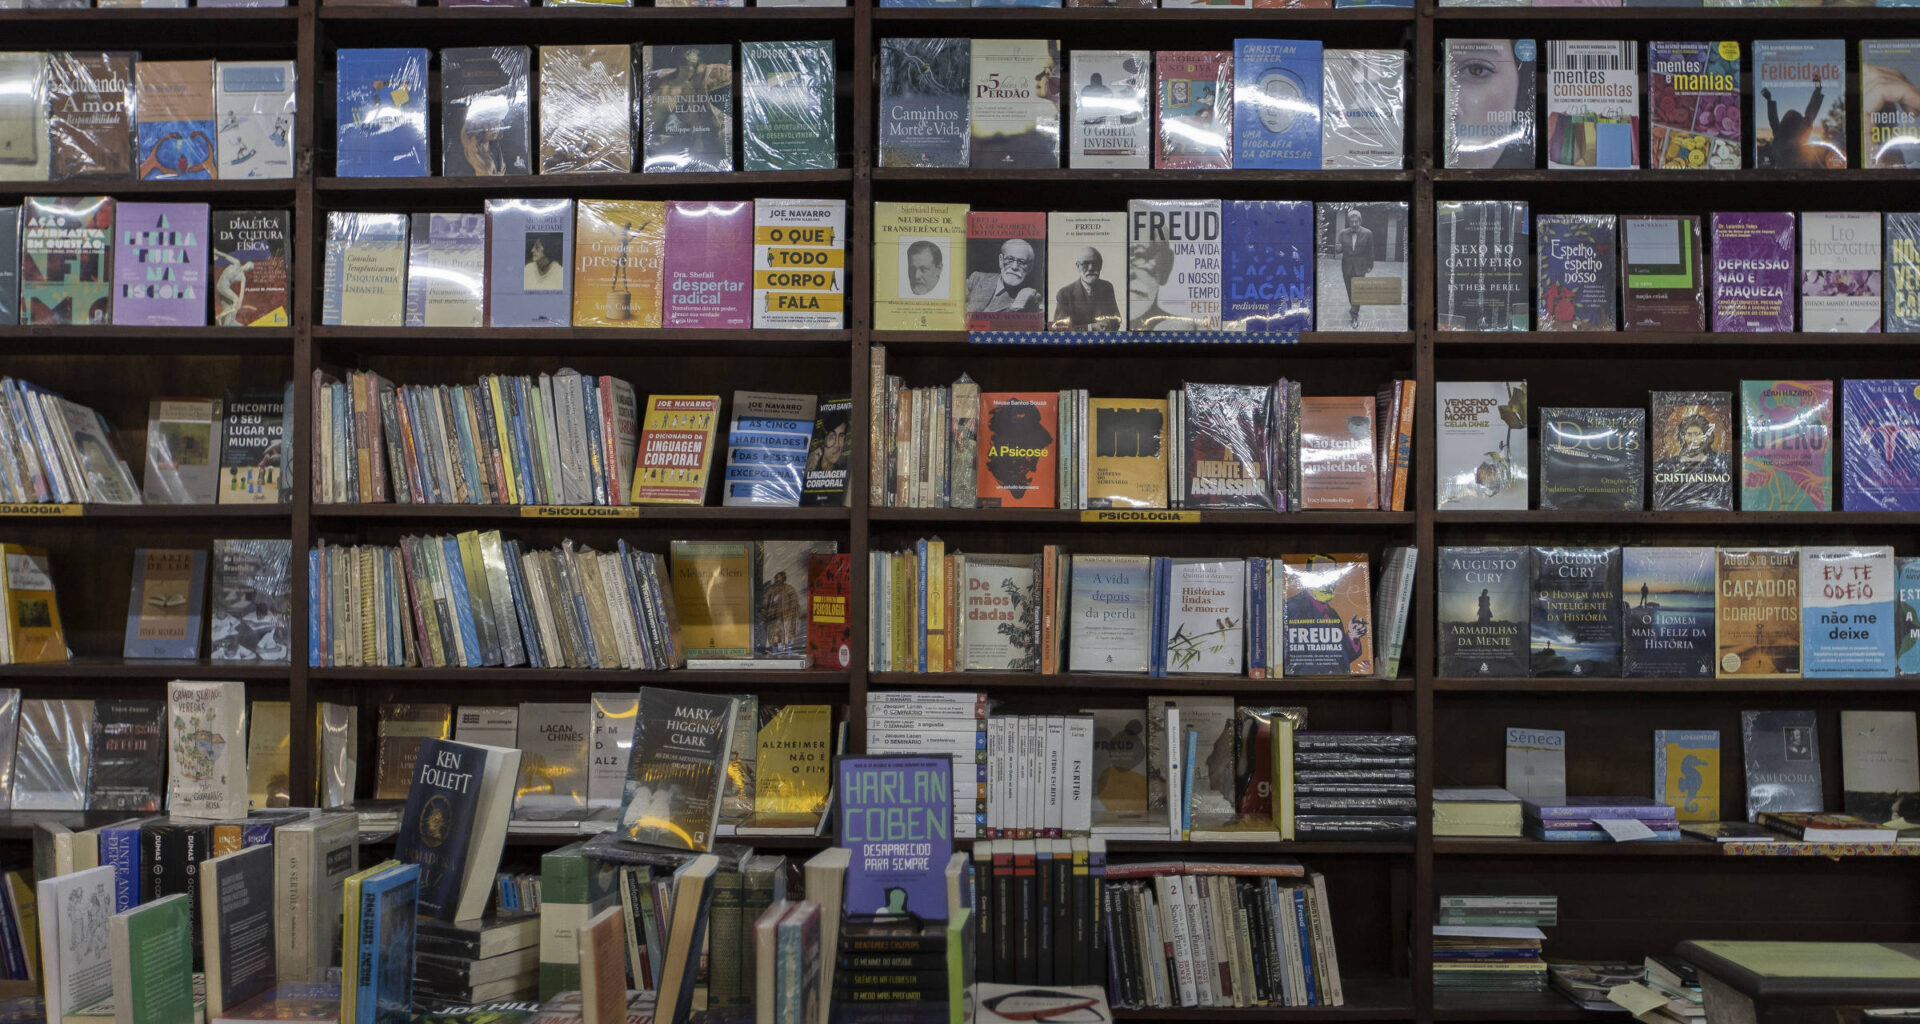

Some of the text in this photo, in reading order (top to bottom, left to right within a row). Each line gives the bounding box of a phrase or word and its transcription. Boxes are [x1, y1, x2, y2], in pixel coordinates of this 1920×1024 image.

[1243, 44, 1296, 54] CHRISTIAN
[1243, 55, 1282, 63] DUNKER
[1657, 61, 1700, 72] mentes
[1762, 62, 1839, 80] Felicidade
[988, 73, 1000, 89] 5
[1554, 69, 1604, 83] mentes
[1674, 72, 1733, 90] manias
[976, 84, 1029, 99] PERDÃO
[1554, 82, 1632, 96] consumistas
[62, 99, 124, 112] Amor
[668, 104, 707, 113] VELADA
[892, 106, 958, 121] Caminhos
[1488, 110, 1530, 122] mentes
[1870, 110, 1915, 123] mentes
[890, 122, 923, 135] Morte
[1084, 126, 1136, 137] O GORILA
[1242, 130, 1261, 139] UMA
[1084, 136, 1136, 148] INVISÍVEL
[1242, 140, 1291, 149] BIOGRAFIA
[1242, 150, 1255, 159] DA
[770, 210, 831, 218] JOE NAVARRO
[931, 207, 948, 215] Freud
[28, 216, 65, 227] AÇÃO
[230, 216, 279, 229] DIALÉTICA
[1133, 211, 1220, 241] FREUD
[220, 231, 283, 240] DA CULTURA
[771, 230, 824, 244] O QUE
[1832, 225, 1854, 241] LEO
[601, 241, 632, 255] poder
[1174, 244, 1220, 255] UMA VIDA
[1454, 244, 1487, 254] SEXO
[1551, 239, 1596, 259] Espelho,
[582, 255, 657, 272] presença
[780, 252, 828, 264] TODO
[1195, 258, 1220, 270] PARA
[1564, 256, 1602, 272] espelho
[1719, 257, 1789, 270] DEPRESSÃO
[346, 273, 398, 283] PSIQUIATRIA
[768, 273, 825, 286] CORPO
[1179, 273, 1220, 284] O NOSSO
[1565, 271, 1596, 283] nosso
[1719, 271, 1744, 283] NÃO
[346, 286, 384, 294] INFANTIL
[673, 279, 744, 293] despertar
[1231, 283, 1304, 299] LACAN
[1490, 283, 1520, 291] PEREL
[1719, 285, 1783, 299] FRAQUEZA
[1188, 287, 1220, 298] TEMPO
[673, 293, 720, 305] radical
[779, 296, 819, 309] FALA
[1191, 302, 1220, 313] PETER
[1232, 303, 1269, 311] redivivus
[230, 415, 261, 424] O SEU
[1445, 413, 1477, 421] MORTE
[230, 426, 283, 436] LUGAR NO
[766, 421, 797, 429] CINCO
[229, 437, 268, 447] MUNDO
[647, 441, 702, 452] LINGUAGEM
[735, 437, 800, 445] HABILIDADES
[989, 446, 1048, 456] A Psicose
[645, 453, 699, 466] CORPORAL
[807, 470, 846, 479] LINGUAGEM
[1656, 472, 1730, 483] CRISTIANISMO
[806, 479, 844, 487] CORPORAL
[0, 506, 61, 514] DAGOGIA
[539, 506, 620, 516] PSICOLOGIA
[1099, 511, 1181, 521] PSICOLOGIA
[1451, 559, 1516, 571] AUGUSTO
[1771, 555, 1794, 565] CURY
[1466, 572, 1503, 584] CURY
[1559, 566, 1596, 578] CURY
[1824, 565, 1872, 580] EU TE
[969, 578, 989, 590] De
[1093, 573, 1129, 584] A vida
[1183, 588, 1225, 596] Histórias
[1552, 590, 1589, 599] HOMEM
[1723, 579, 1796, 600] CAÇADOR
[969, 593, 1009, 606] mãos
[1092, 590, 1130, 603] depois
[1182, 596, 1211, 604] lindas
[813, 603, 845, 616] PSICOLOGIA
[1182, 604, 1192, 612] de
[1547, 601, 1607, 611] INTELIGENTE
[969, 608, 1014, 621] dadas
[1086, 608, 1136, 621] da perda
[1564, 611, 1607, 622] HISTÓRIA
[1643, 615, 1696, 625] O HOMEM
[1723, 607, 1797, 621] CORRUPTOS
[1821, 611, 1877, 623] não me
[1289, 628, 1343, 642] FREUD
[1451, 625, 1517, 635] ARMADILHAS
[1632, 626, 1706, 638] MAIS FELIZ DA
[1829, 628, 1869, 640] deixe
[1459, 636, 1511, 646] DA MENTE
[1645, 638, 1694, 649] HISTÓRIA
[675, 706, 713, 721] MARY
[540, 725, 573, 733] LACAN
[666, 721, 715, 735] HIGGINS
[548, 731, 584, 742] CHINÊS
[671, 734, 707, 747] CLARK
[1510, 729, 1562, 747] Sêneca
[436, 750, 461, 768] KEN
[789, 752, 814, 761] NÃO
[792, 766, 799, 774] O
[420, 765, 473, 794] FOLLETT
[1073, 760, 1081, 800] ESCRITOS
[1754, 774, 1815, 782] SABEDORIA
[846, 771, 946, 804] HARLAN
[846, 808, 946, 842] COBEN
[119, 836, 129, 875] VINTE
[864, 843, 931, 857] DESAPARECIDO
[865, 858, 930, 871] PARA SEMPRE
[1297, 904, 1305, 927] Freud
[432, 1003, 541, 1015] JOE HILL
